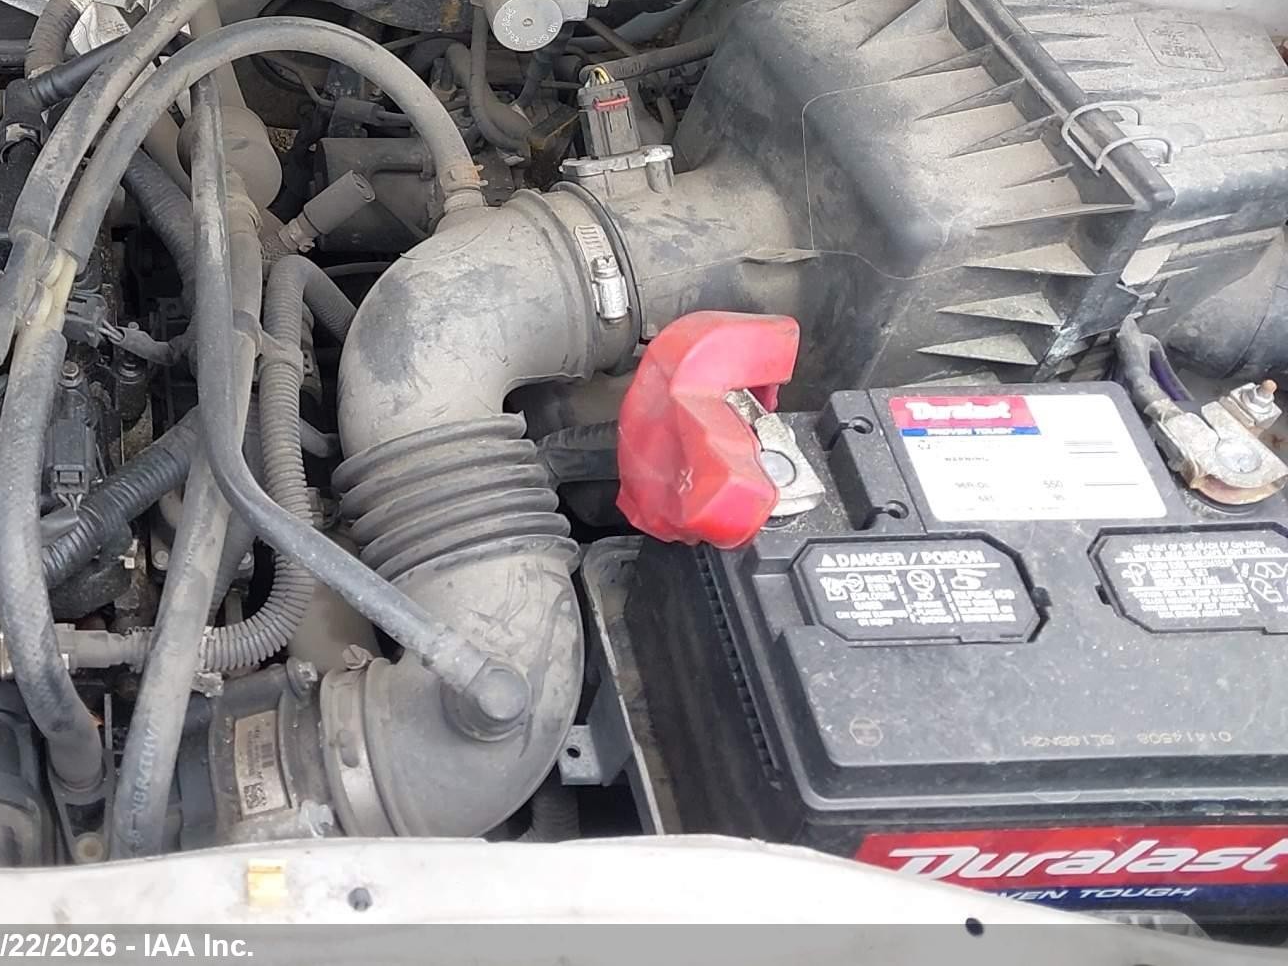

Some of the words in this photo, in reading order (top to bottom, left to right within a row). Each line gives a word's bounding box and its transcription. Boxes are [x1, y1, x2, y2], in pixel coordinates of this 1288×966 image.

[904, 400, 1013, 421] Duralast
[835, 552, 907, 567] DANGER
[922, 550, 986, 565] POISON
[887, 837, 1288, 881] Duralast
[999, 888, 1069, 901] VEN
[1079, 887, 1197, 899] TOUGH
